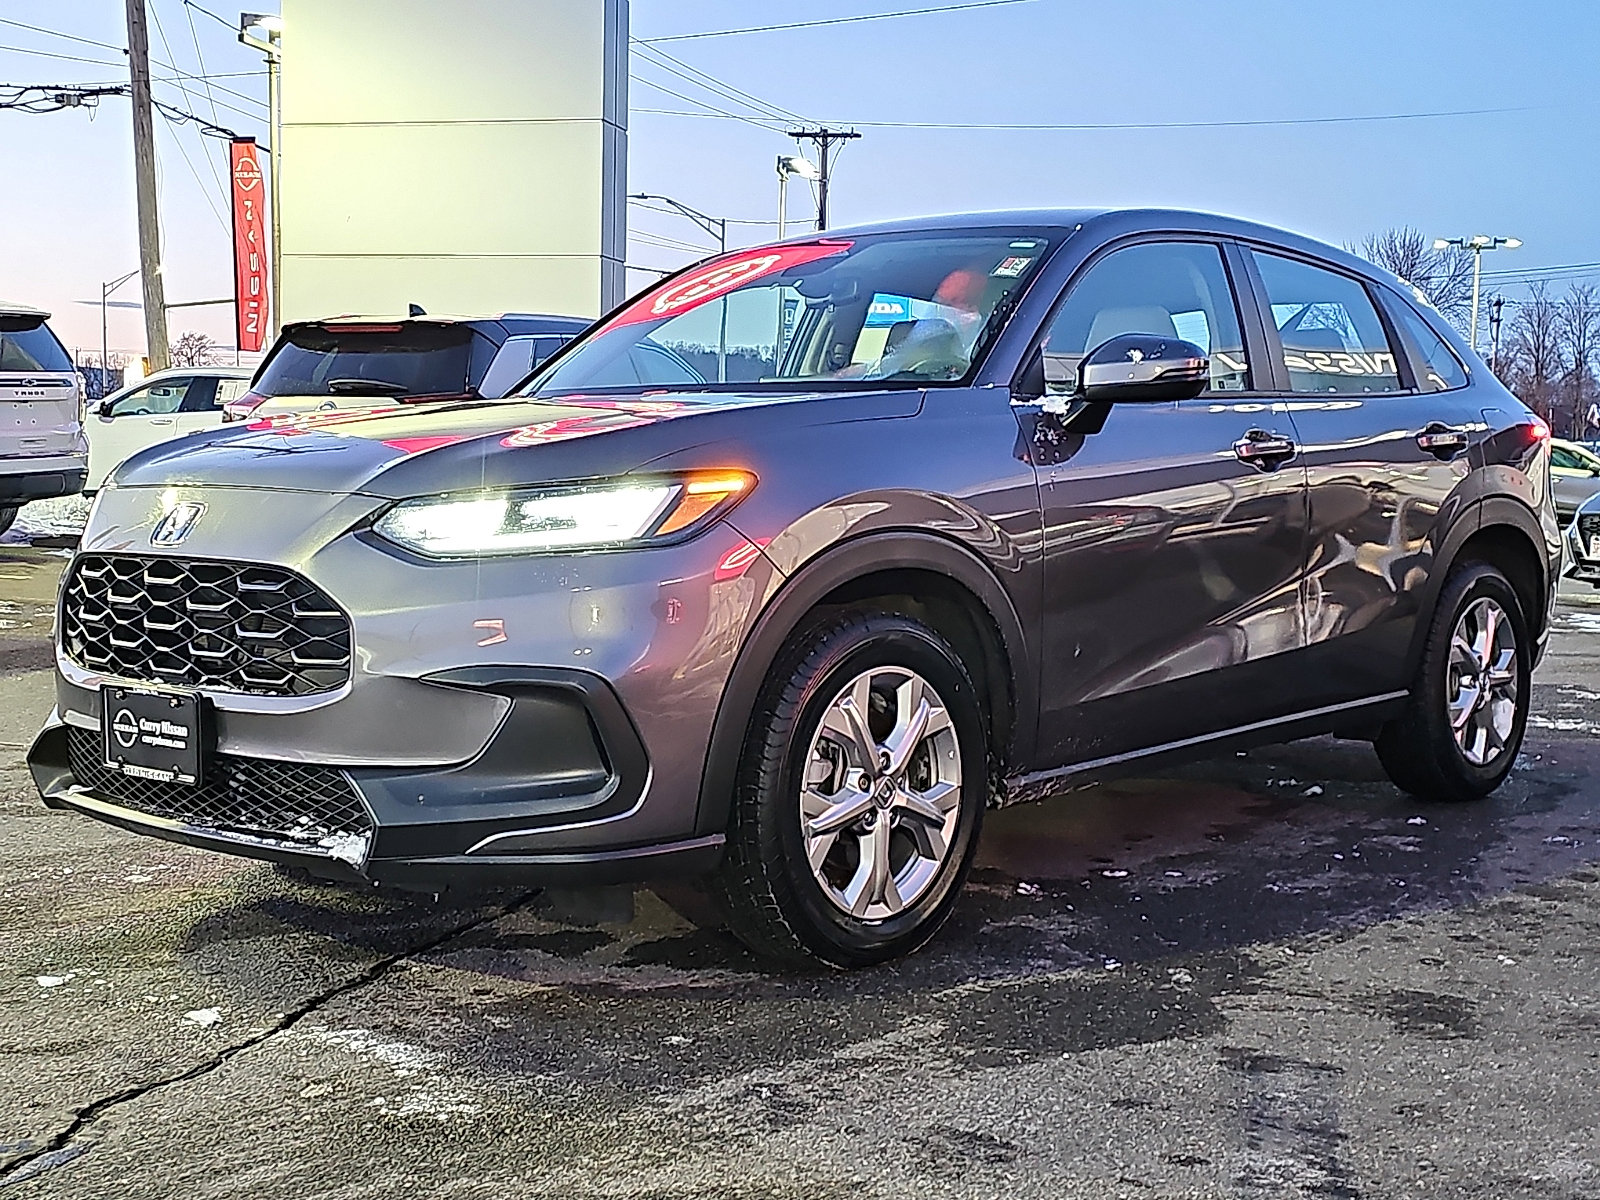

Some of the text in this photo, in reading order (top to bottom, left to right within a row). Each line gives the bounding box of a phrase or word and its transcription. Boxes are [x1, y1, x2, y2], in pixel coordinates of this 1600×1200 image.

[243, 200, 260, 333] NISSAN
[140, 718, 188, 737] Curry Nissan
